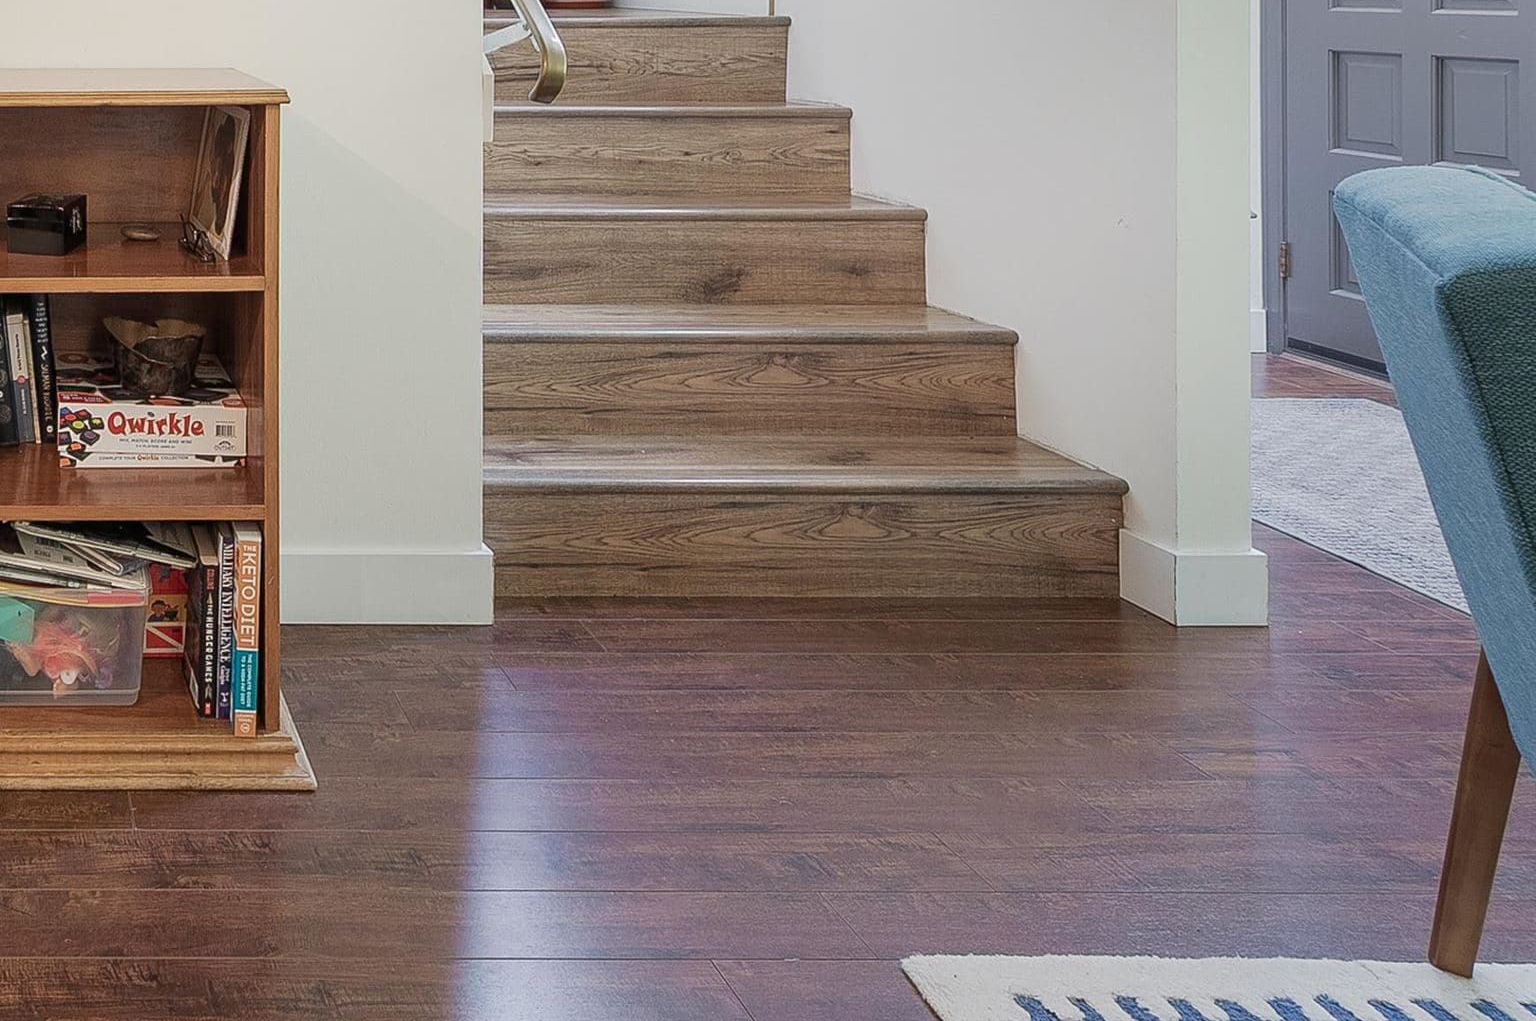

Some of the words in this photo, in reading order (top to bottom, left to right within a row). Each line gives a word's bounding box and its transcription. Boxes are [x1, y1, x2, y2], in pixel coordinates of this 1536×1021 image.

[40, 364, 50, 390] SALMAN
[107, 411, 205, 437] Qwirkle
[221, 543, 233, 588] MILITARY
[241, 552, 257, 600] KETO
[205, 617, 213, 653] HUNGER
[221, 590, 233, 664] INTELLIGENCE
[240, 604, 255, 646] DIET
